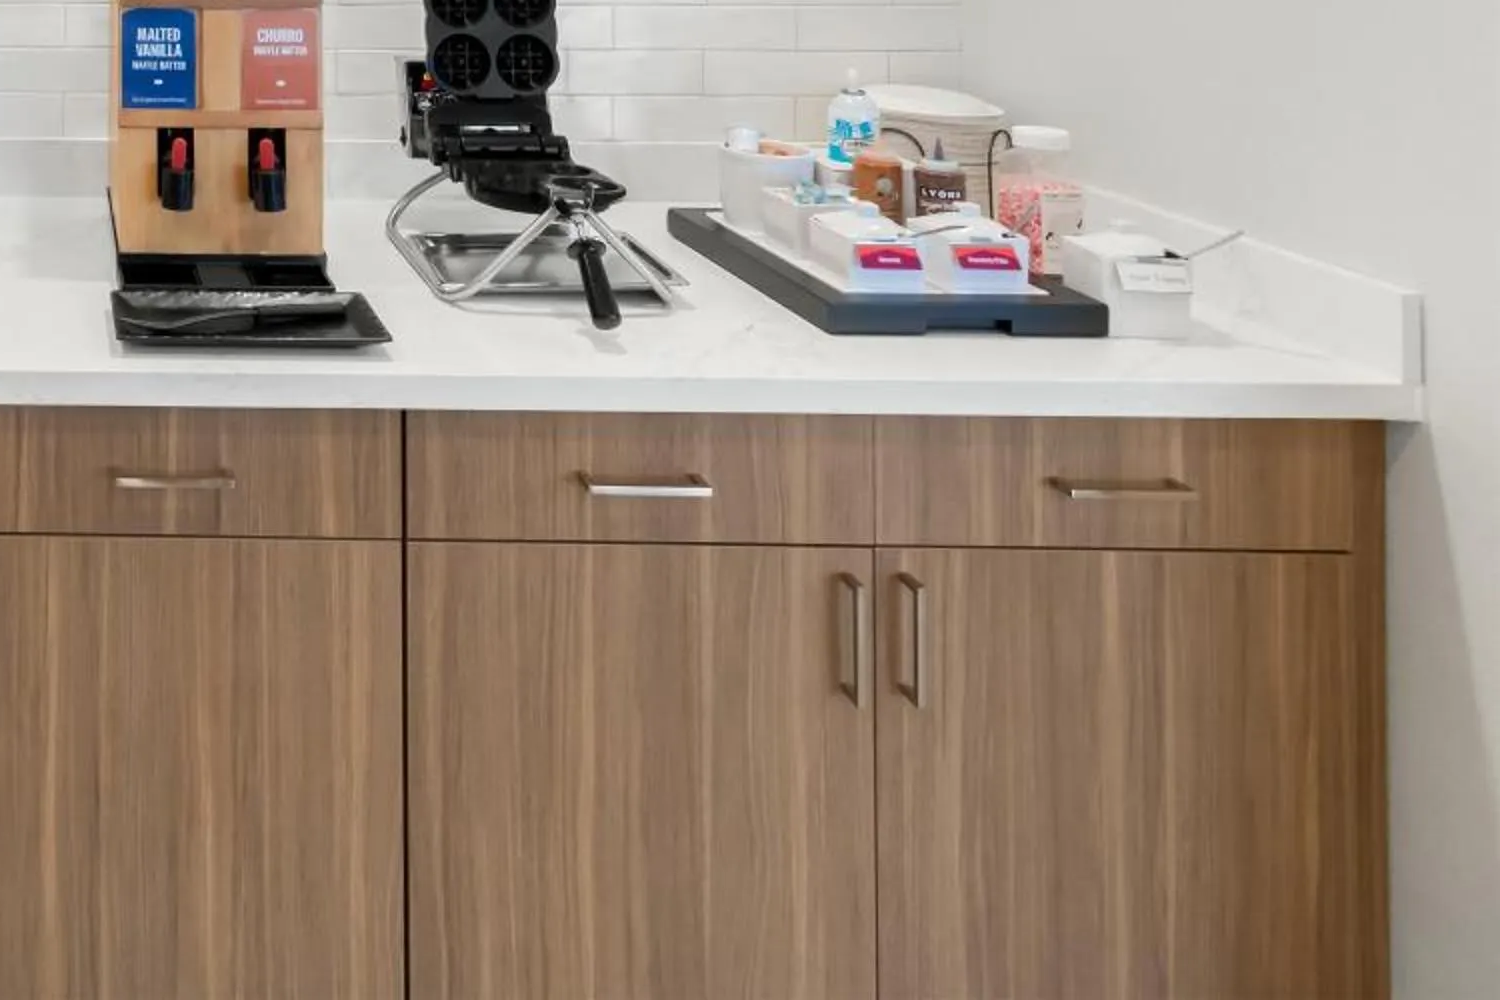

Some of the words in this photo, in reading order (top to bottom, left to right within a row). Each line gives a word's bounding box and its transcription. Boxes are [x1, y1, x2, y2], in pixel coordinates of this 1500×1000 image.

[136, 27, 181, 42] MALTED
[256, 28, 304, 43] CHURRO
[135, 43, 183, 57] VANILLA
